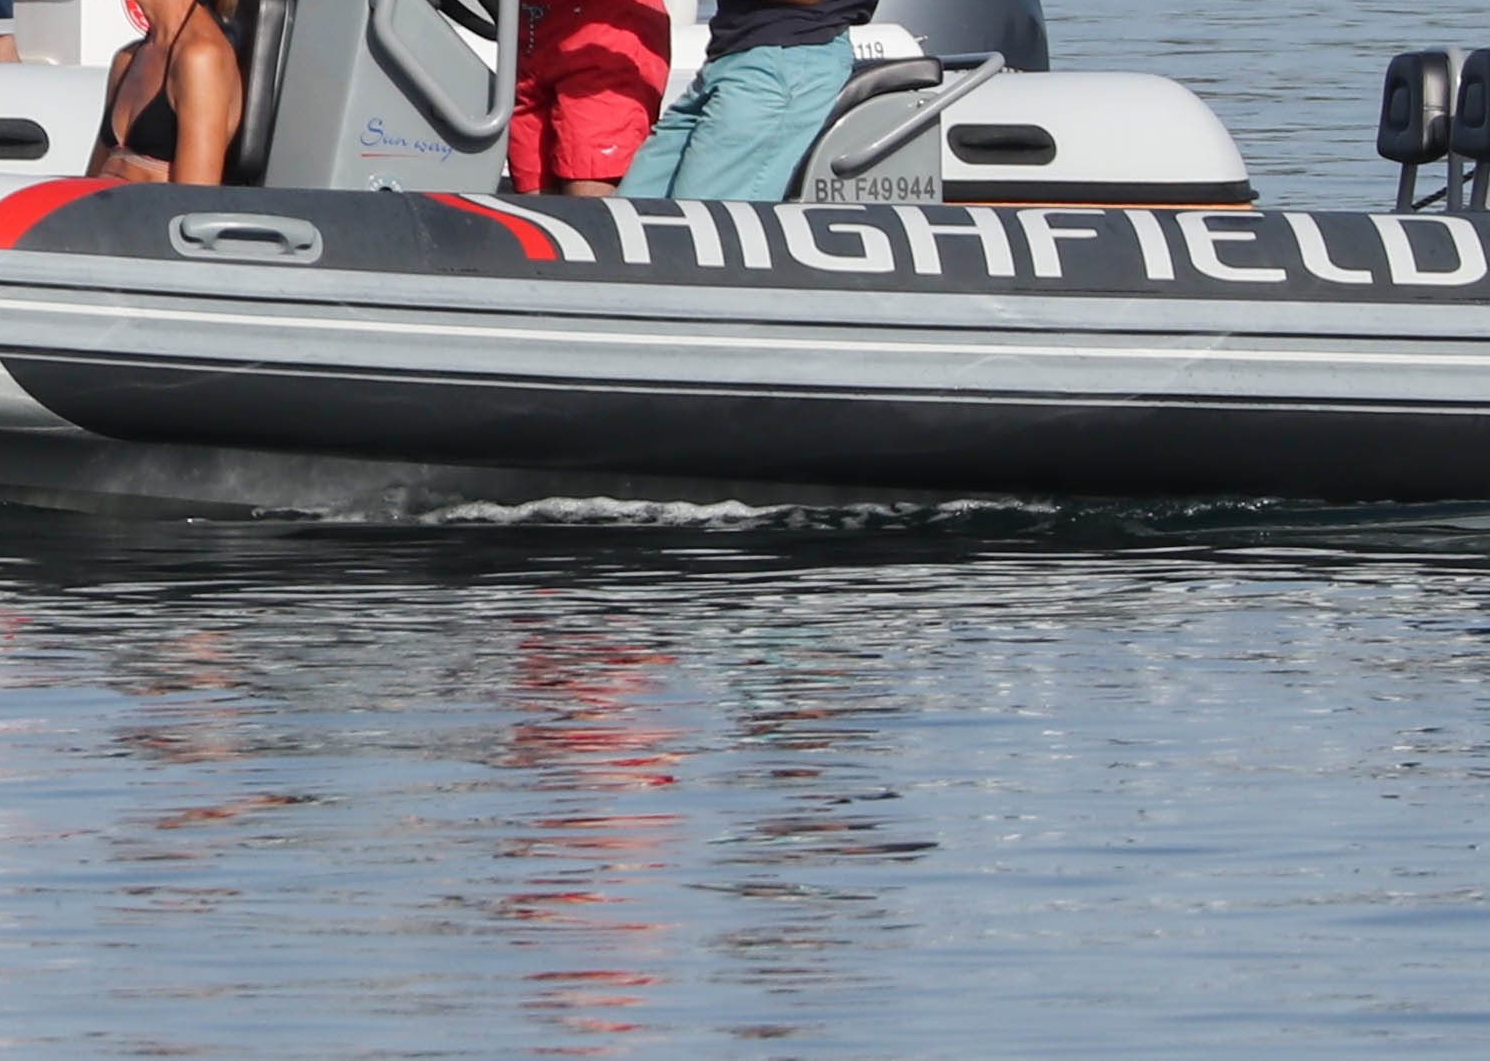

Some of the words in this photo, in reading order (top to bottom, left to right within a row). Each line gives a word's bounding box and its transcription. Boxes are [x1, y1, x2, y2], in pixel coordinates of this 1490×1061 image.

[360, 118, 407, 146] Sun
[815, 179, 846, 202] BR
[602, 198, 1488, 285] HIGHFIELD
